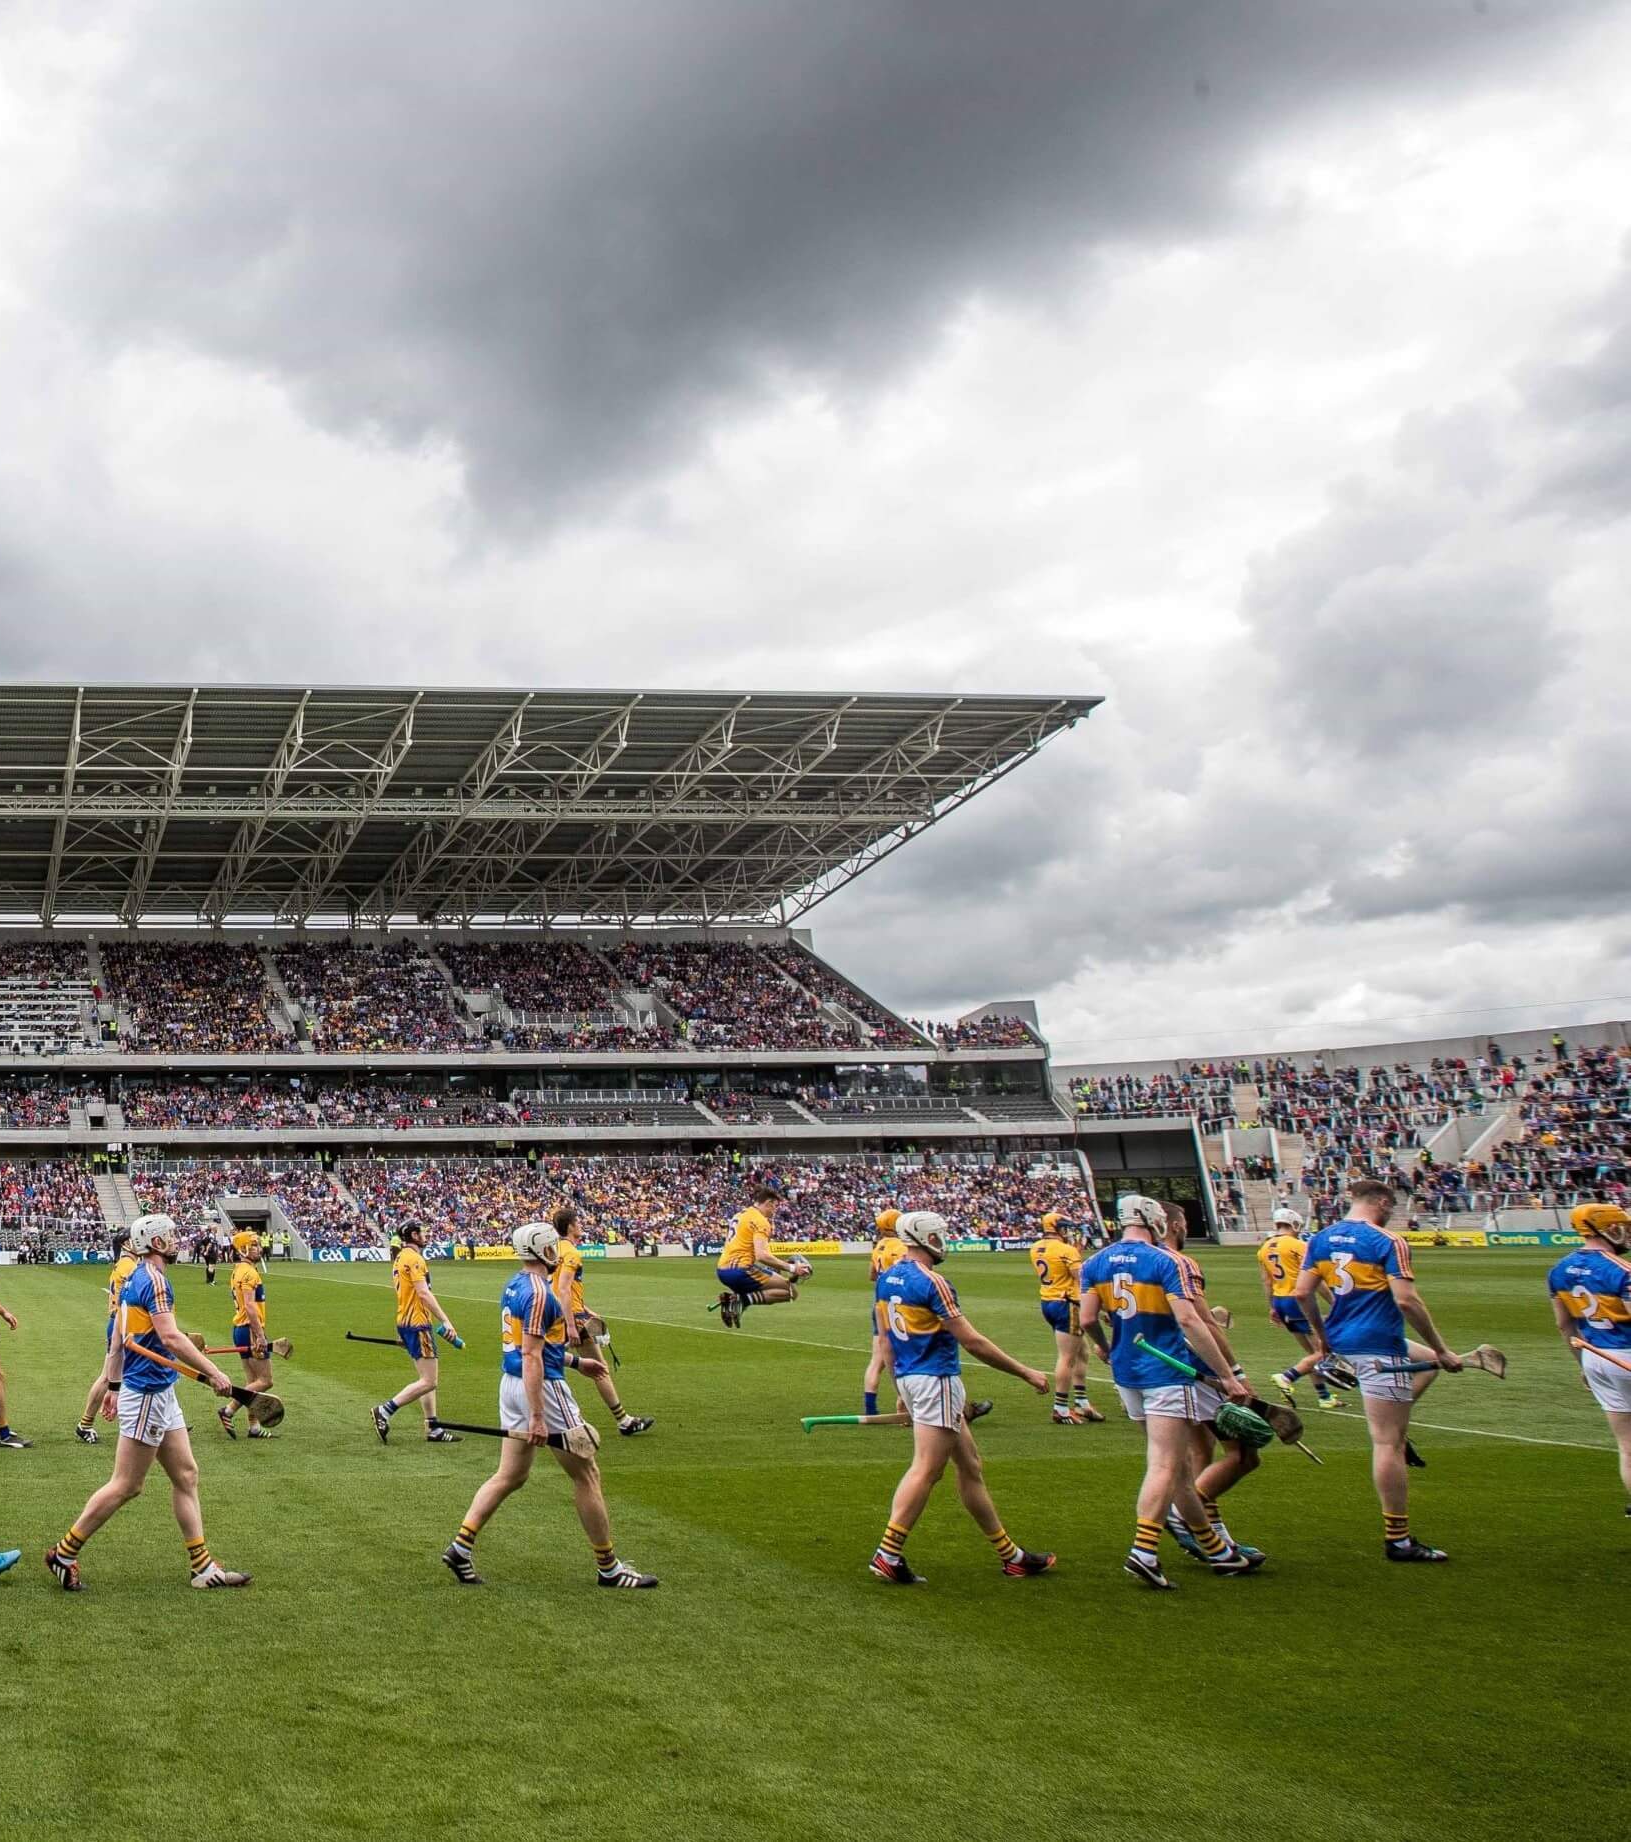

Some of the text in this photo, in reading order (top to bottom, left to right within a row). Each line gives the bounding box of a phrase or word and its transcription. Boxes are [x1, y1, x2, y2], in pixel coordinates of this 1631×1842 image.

[422, 1246, 447, 1260] GAA
[955, 1239, 991, 1251] Centra
[1488, 1234, 1540, 1245] Centra
[318, 1248, 346, 1261] GAA
[1268, 1253, 1286, 1280] 3
[1036, 1259, 1054, 1286] 2
[1330, 1251, 1355, 1296] 3
[1112, 1272, 1137, 1320] 5
[1571, 1284, 1616, 1331] 2
[888, 1295, 910, 1342] 6
